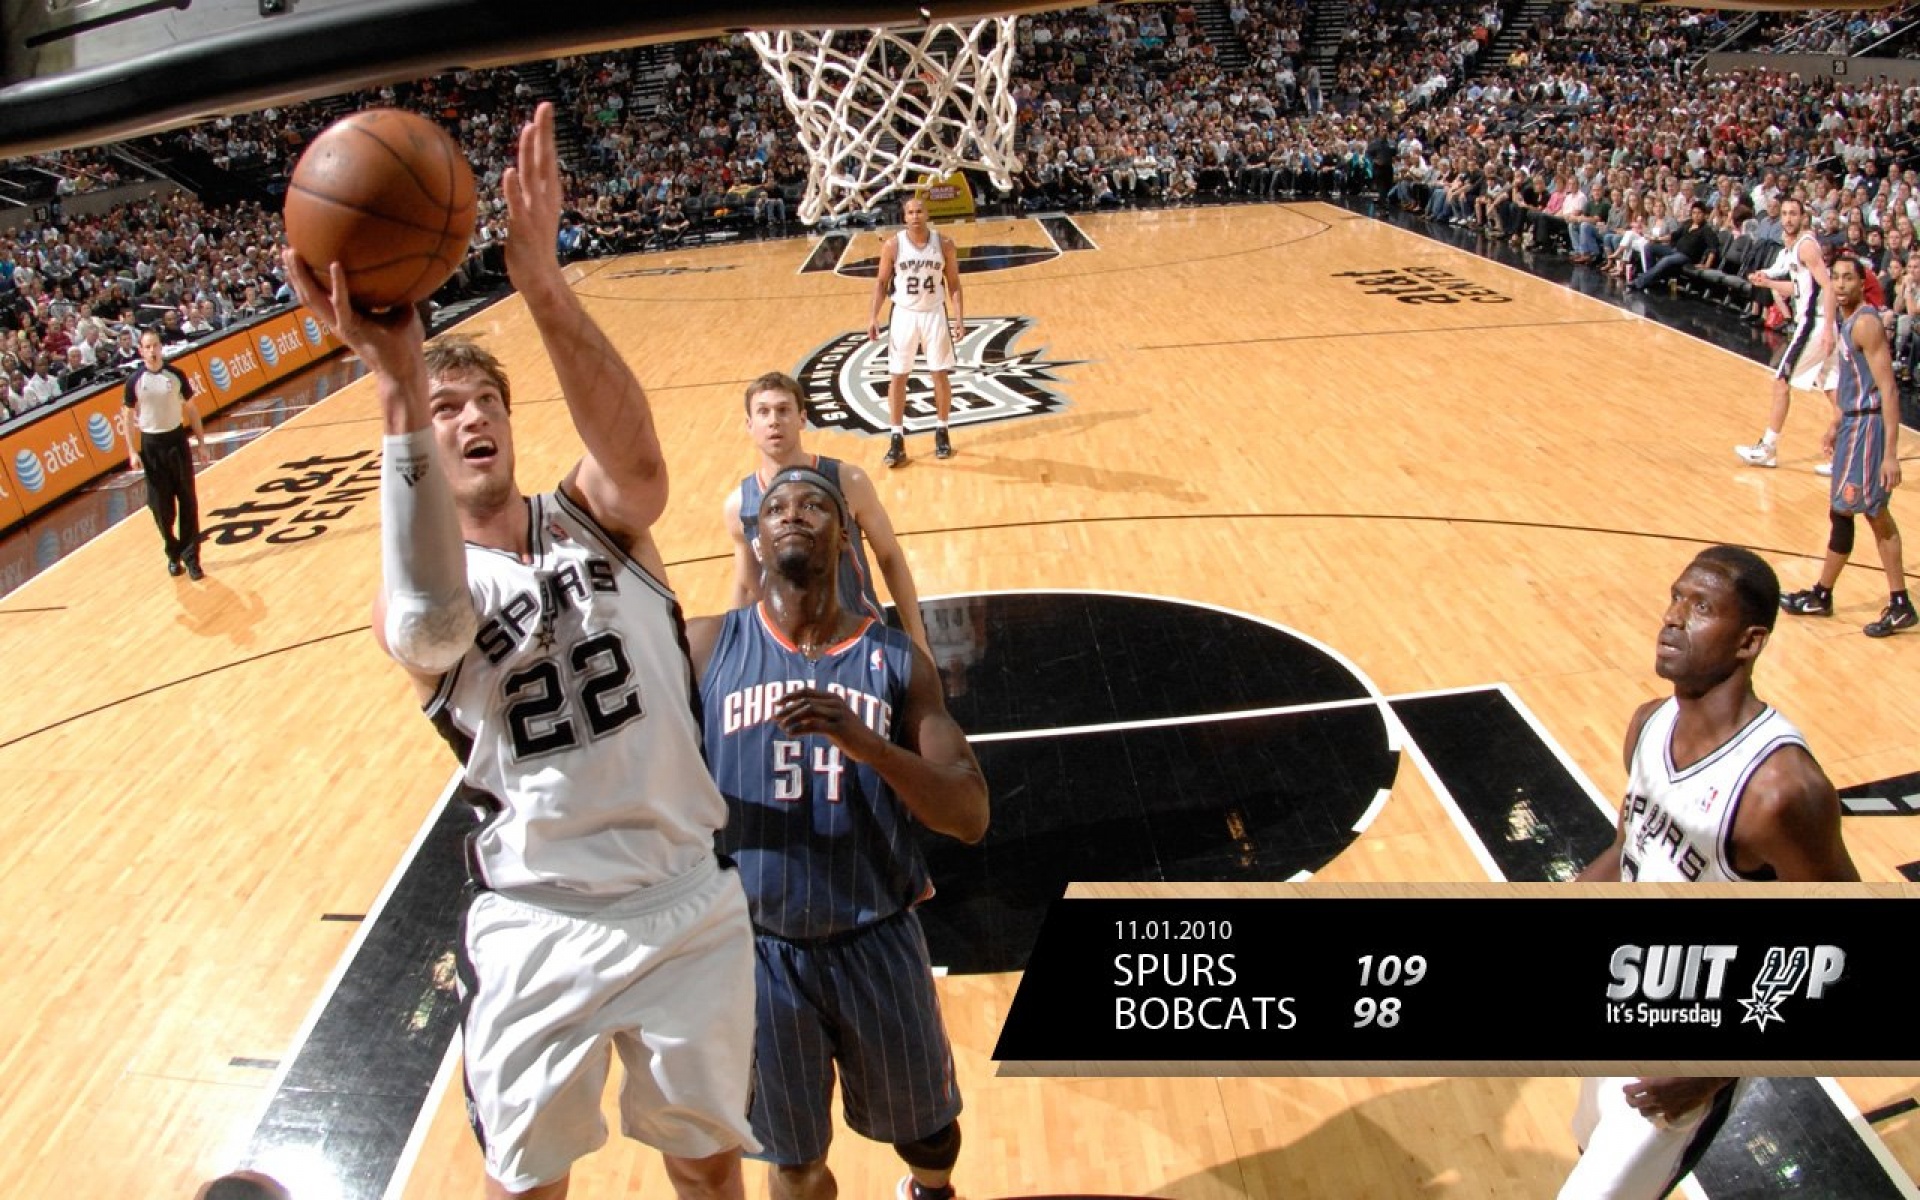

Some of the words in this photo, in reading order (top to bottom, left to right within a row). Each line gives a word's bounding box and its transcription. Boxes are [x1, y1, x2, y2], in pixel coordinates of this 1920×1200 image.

[899, 260, 942, 275] SPURS
[906, 275, 935, 295] 24
[277, 328, 303, 355] at&t
[229, 348, 258, 379] at&t
[809, 391, 849, 421] SAN
[43, 432, 84, 474] at&t
[197, 449, 374, 545] at&t
[502, 629, 646, 763] 22
[773, 740, 844, 803] 54
